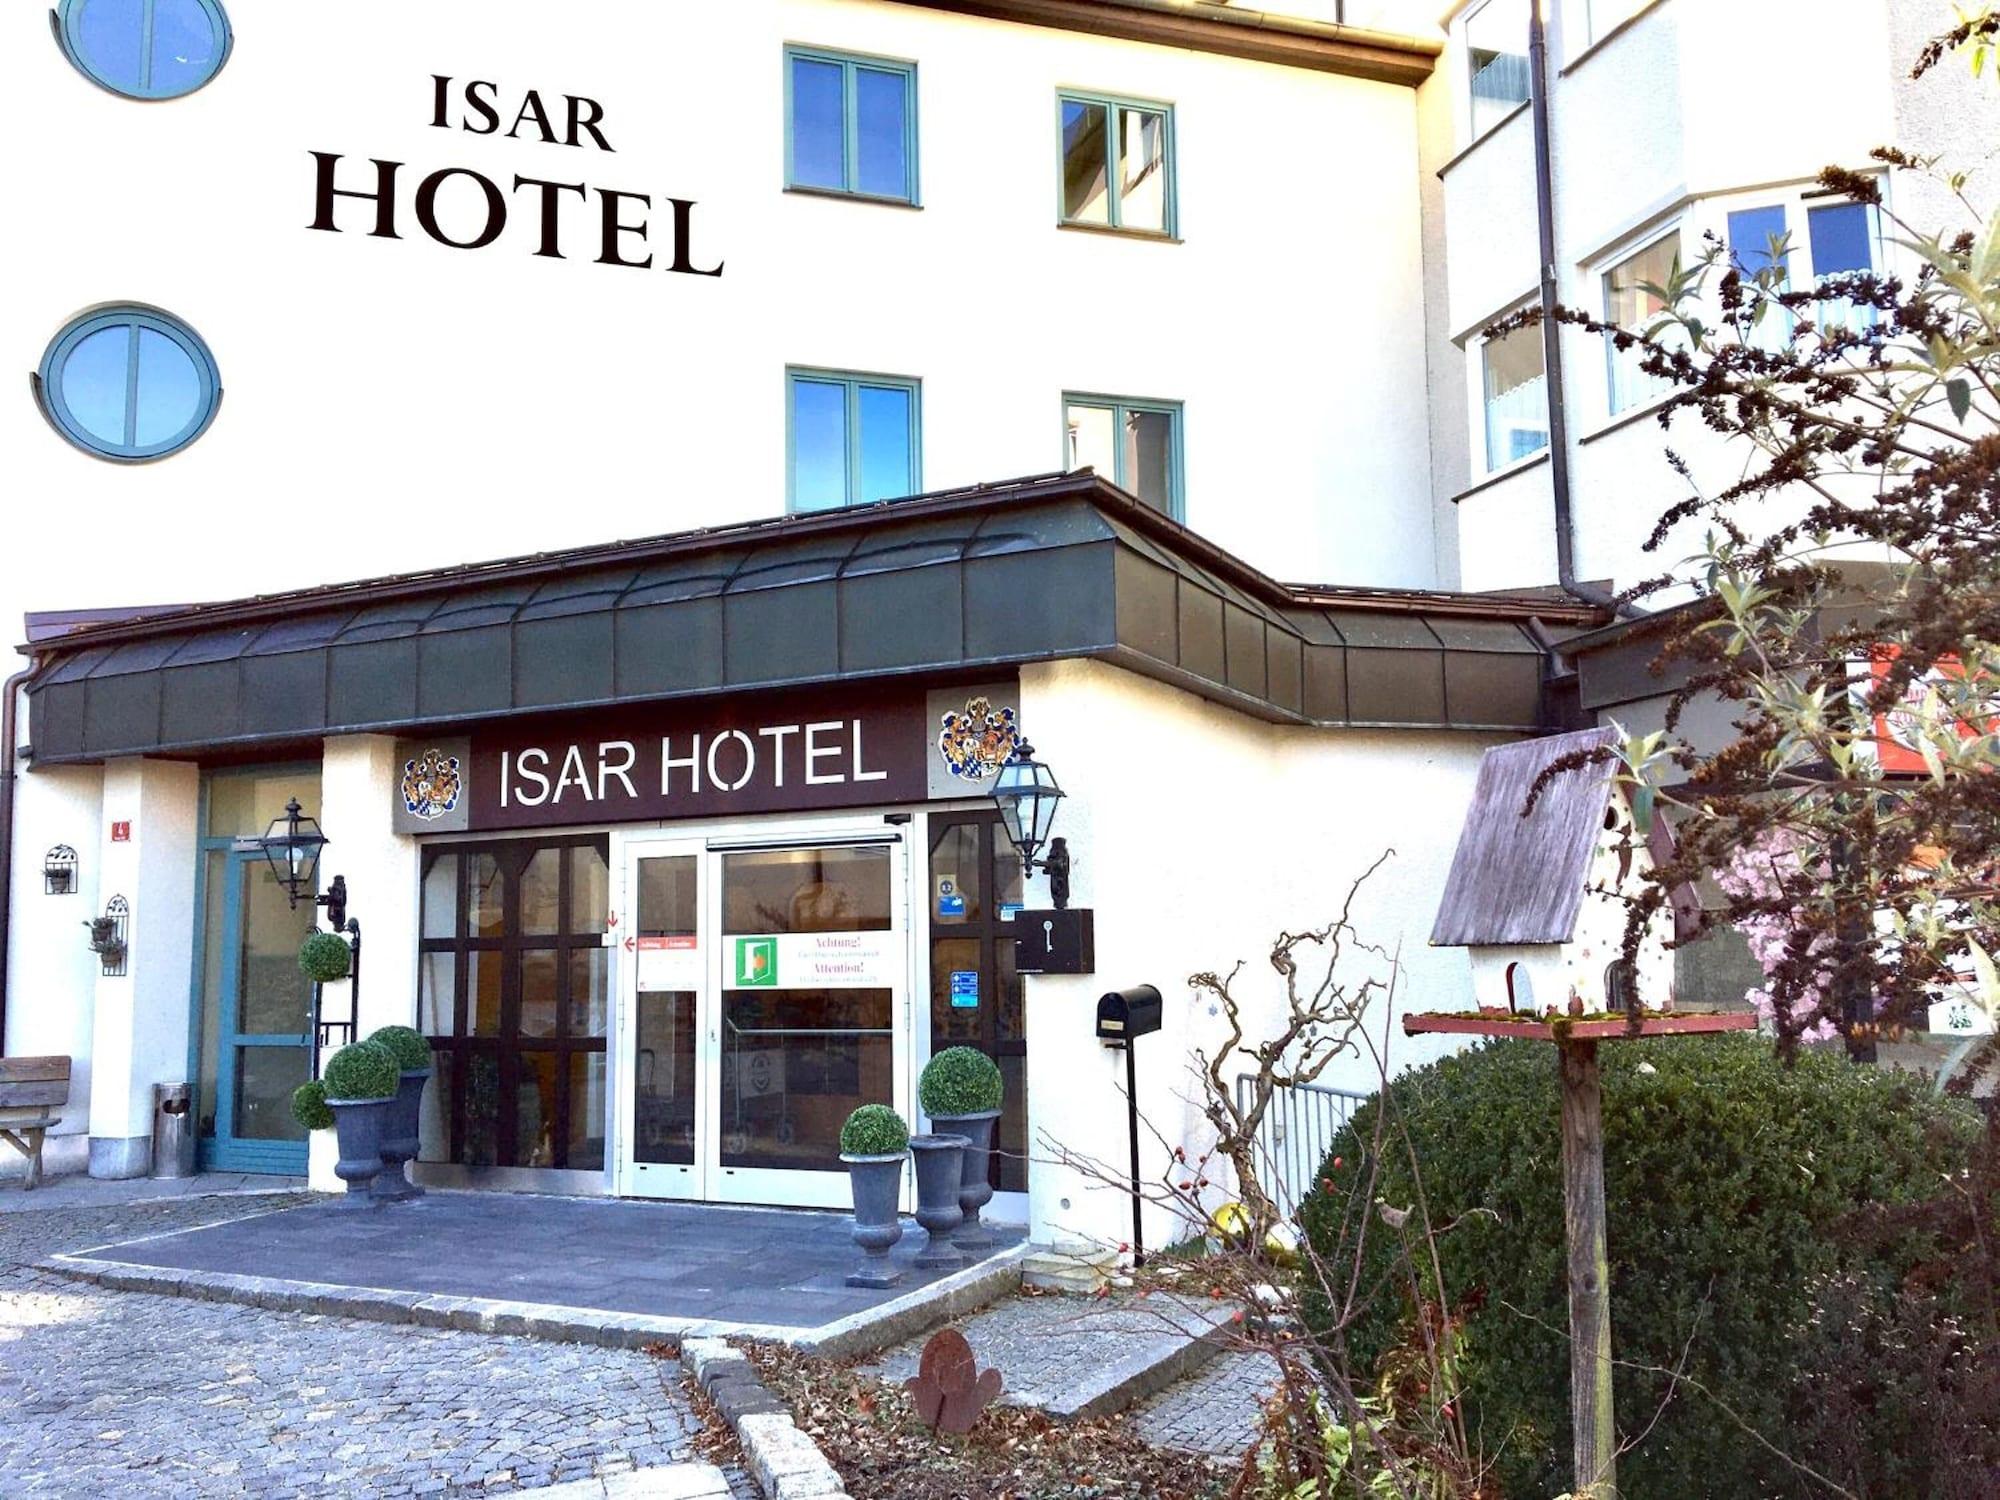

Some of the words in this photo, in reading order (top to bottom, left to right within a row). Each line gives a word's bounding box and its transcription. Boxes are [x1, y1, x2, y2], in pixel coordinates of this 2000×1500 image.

[429, 74, 617, 152] ISAR
[305, 150, 725, 278] HOTEL
[500, 740, 638, 808] ISAR
[660, 718, 888, 796] HOTEL
